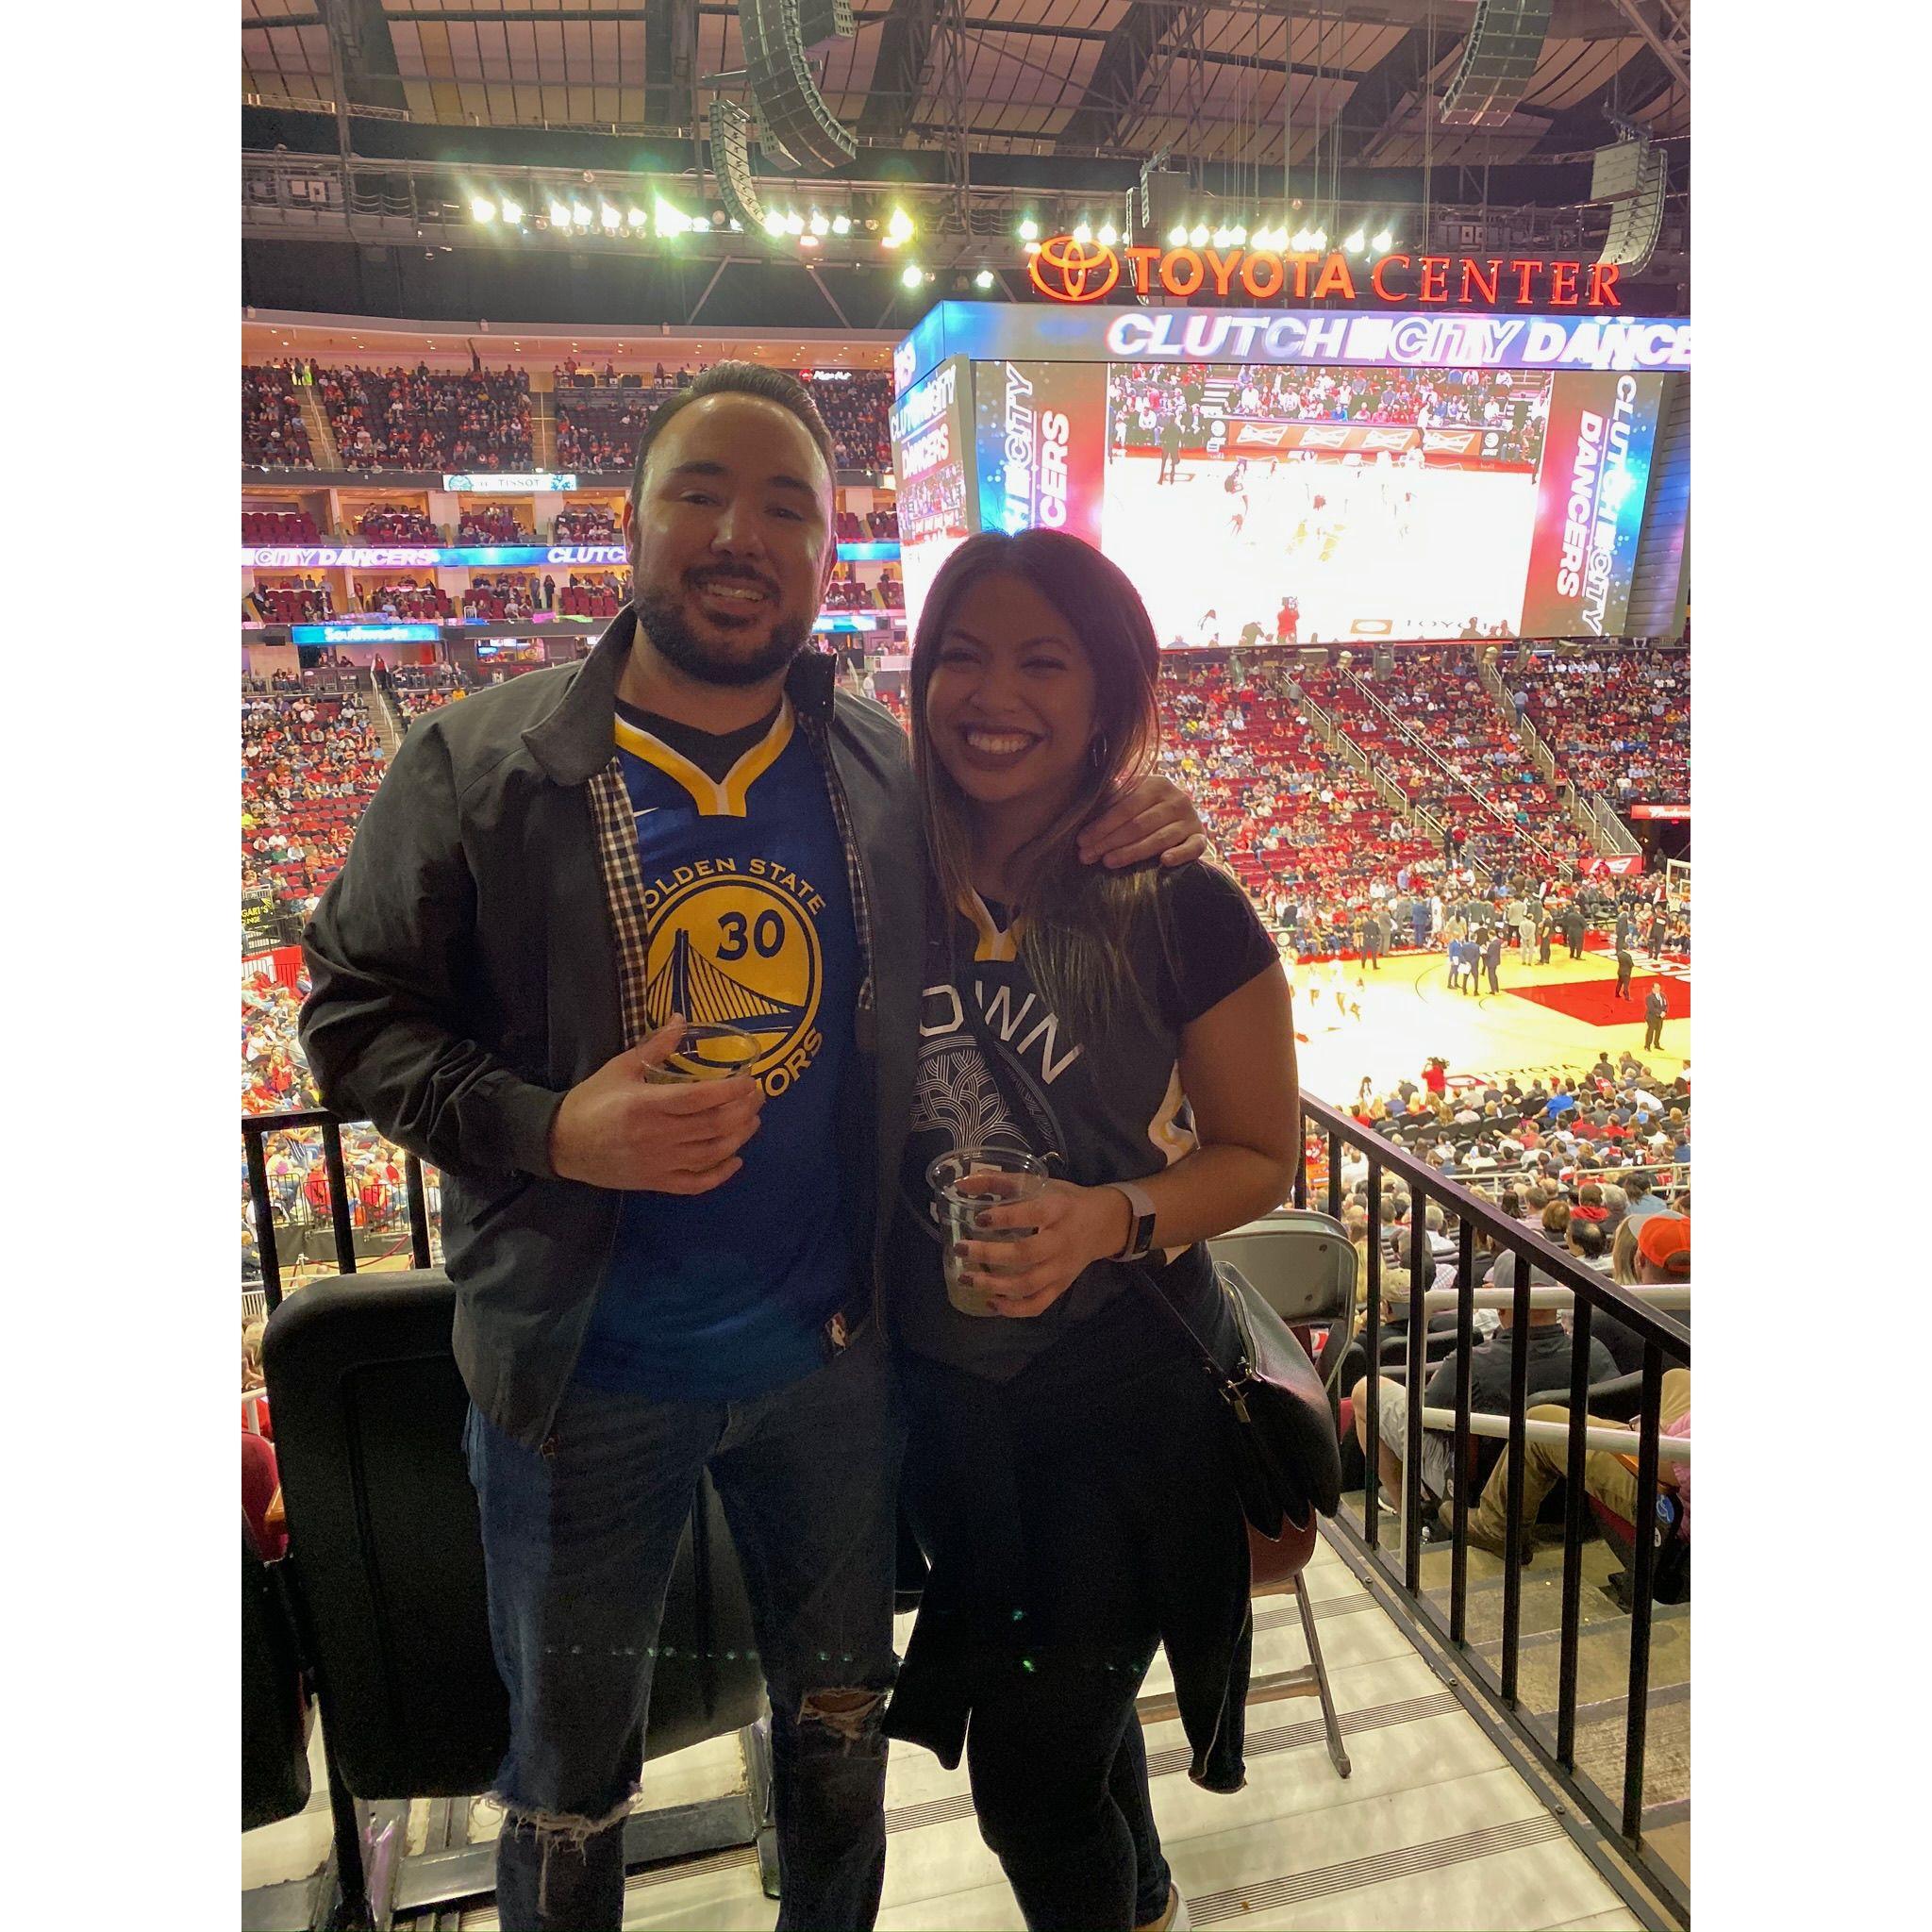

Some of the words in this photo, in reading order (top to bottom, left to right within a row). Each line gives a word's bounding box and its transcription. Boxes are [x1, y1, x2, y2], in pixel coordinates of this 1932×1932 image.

[1125, 244, 1357, 300] TOYOTA
[1371, 254, 1623, 308] CENTER
[1107, 312, 1344, 358] CLUTCH
[498, 478, 541, 487] TISSOT
[1040, 410, 1070, 528] CERS
[1557, 409, 1604, 598] DANCERS
[317, 548, 441, 567] DANCERS
[547, 547, 628, 564] CLUTC
[644, 858, 737, 909] OLDEN
[747, 858, 827, 915] STATE
[716, 908, 786, 961] 30
[919, 979, 1084, 1085] OWN
[758, 1026, 824, 1097] ORS
